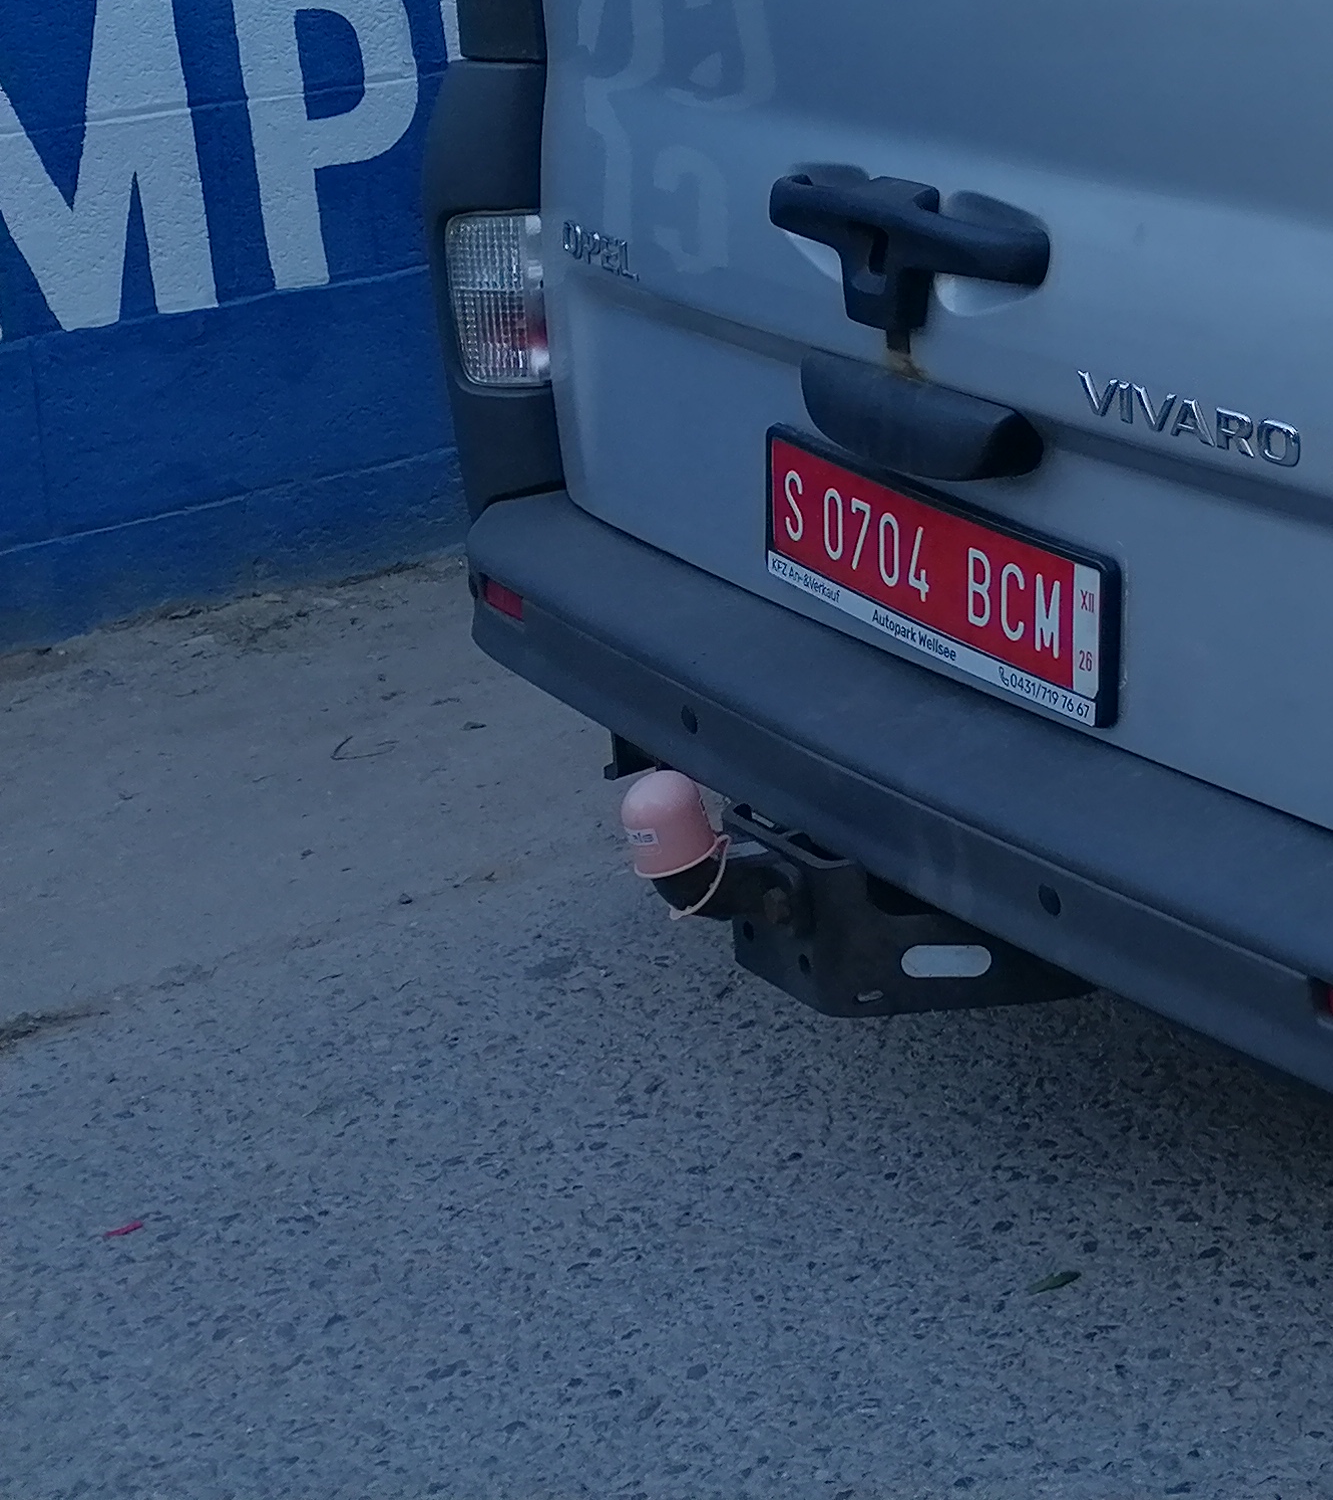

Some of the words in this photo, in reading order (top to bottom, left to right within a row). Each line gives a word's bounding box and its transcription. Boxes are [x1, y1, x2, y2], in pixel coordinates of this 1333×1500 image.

[562, 220, 640, 282] OPEL
[1077, 368, 1302, 469] VIVARO
[784, 470, 804, 542] S
[823, 487, 930, 603] 0704
[967, 546, 1062, 659] BCM
[872, 609, 917, 643] Autopark
[918, 632, 958, 662] Wellsee
[1078, 649, 1093, 673] 26
[1009, 673, 1059, 706] 0431/719
